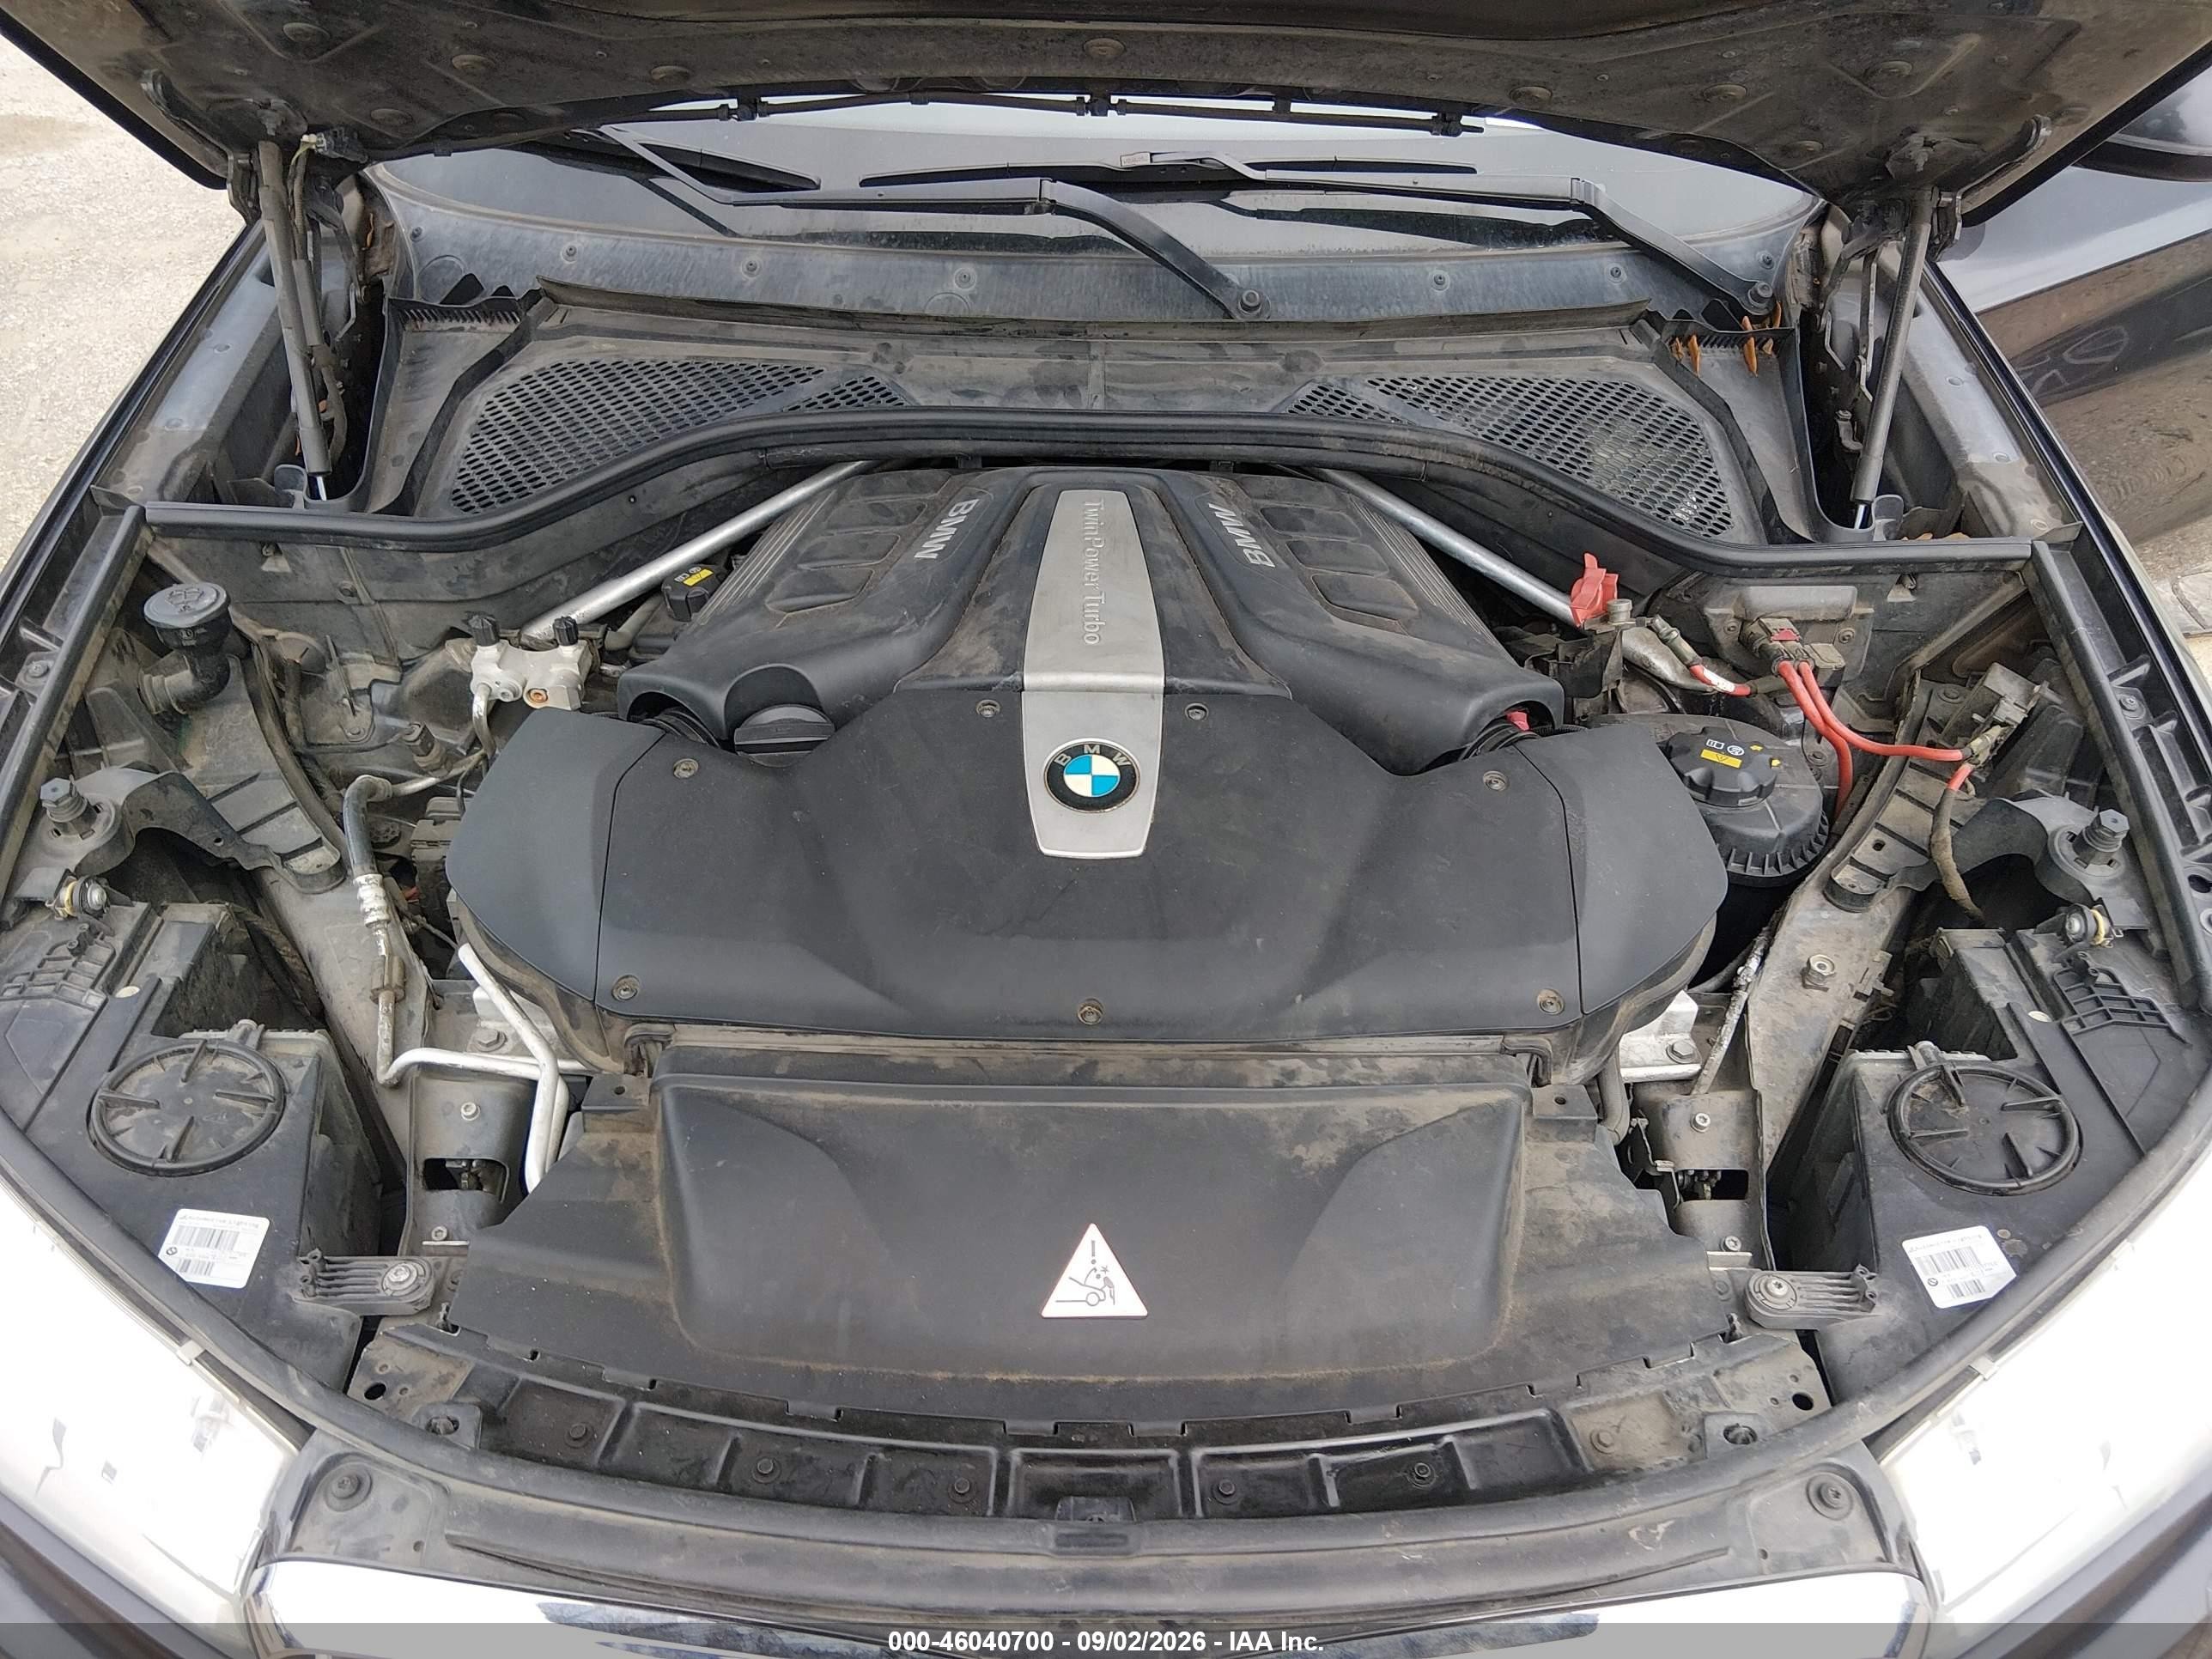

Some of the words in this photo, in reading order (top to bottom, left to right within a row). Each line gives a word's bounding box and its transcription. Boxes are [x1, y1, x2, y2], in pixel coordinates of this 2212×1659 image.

[914, 499, 980, 559] BMW
[1207, 502, 1275, 568] BMW
[1083, 590, 1106, 645] Turbo
[1054, 744, 1131, 767] BMW
